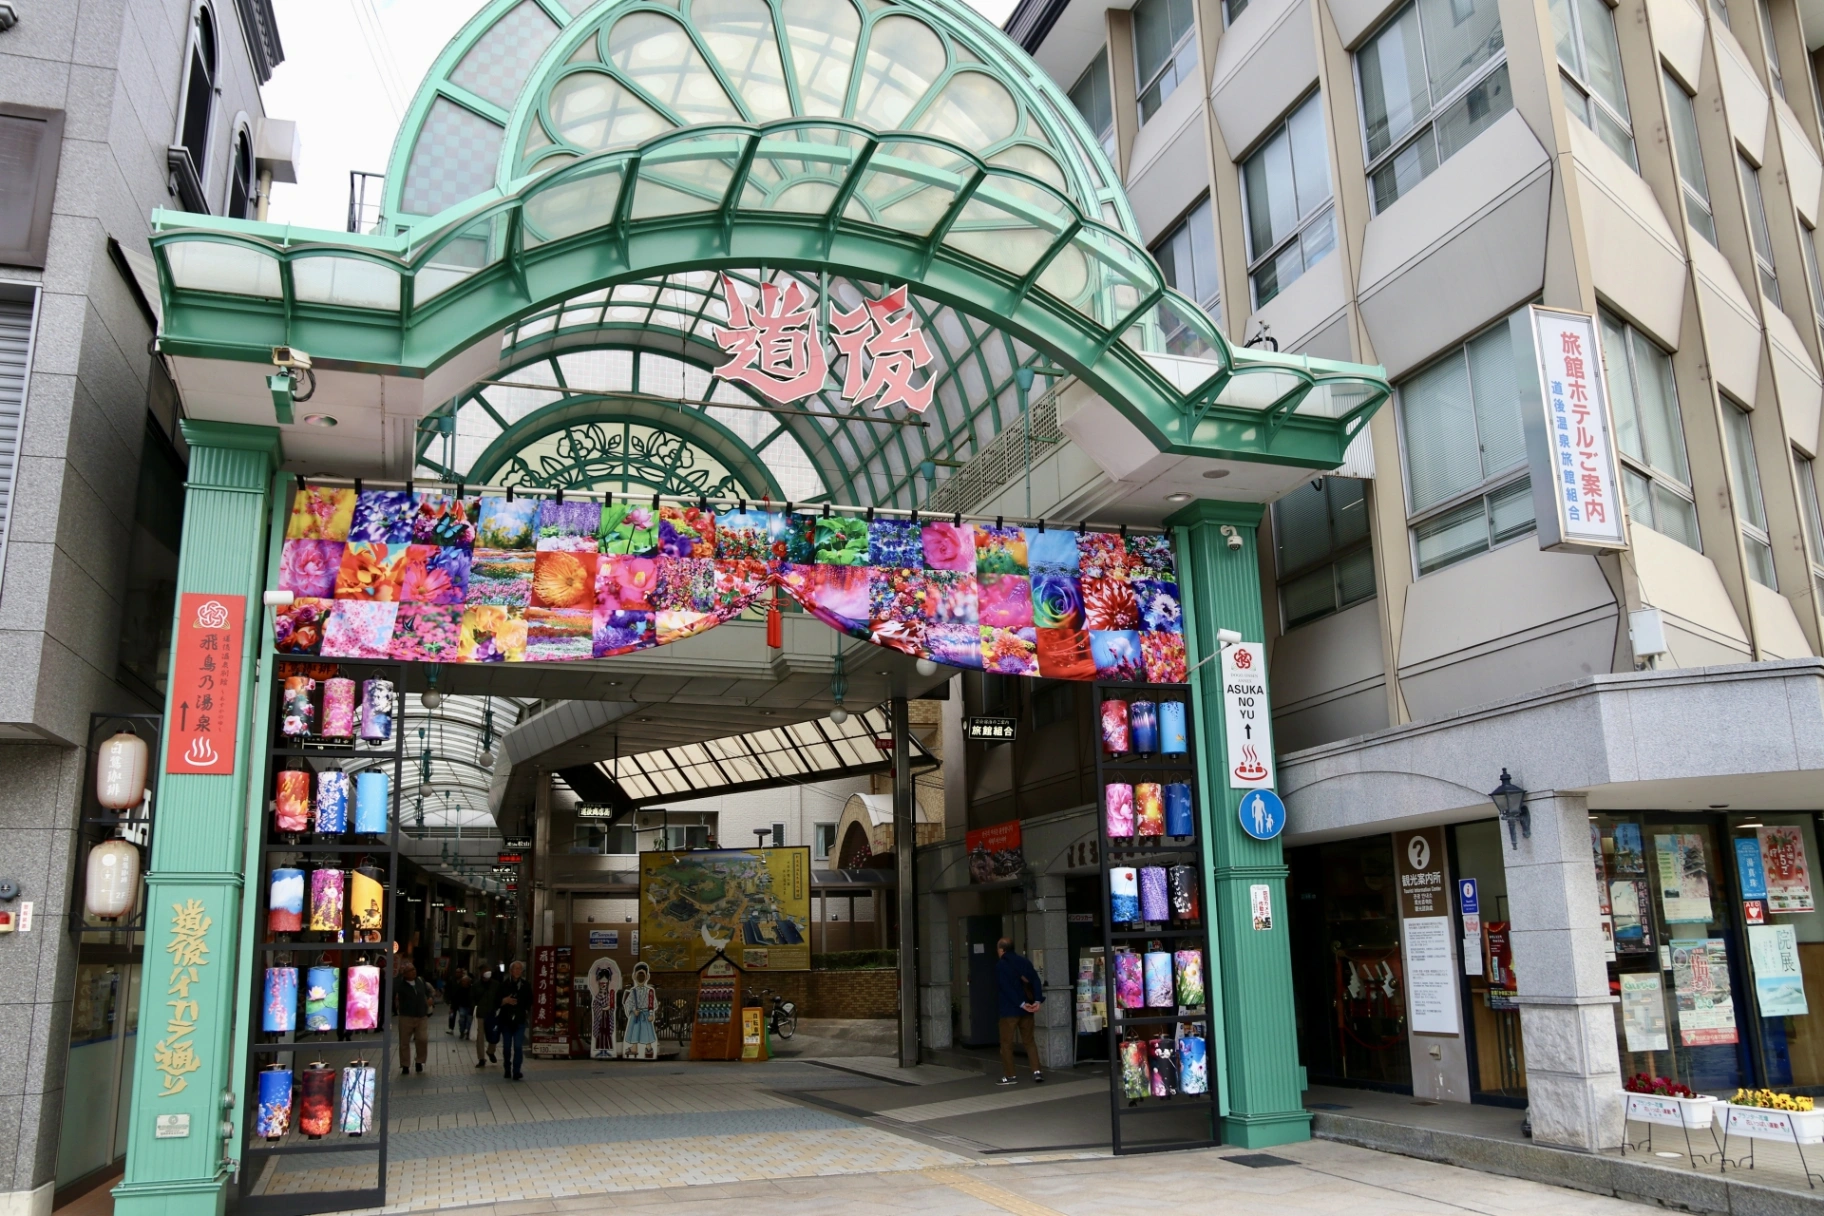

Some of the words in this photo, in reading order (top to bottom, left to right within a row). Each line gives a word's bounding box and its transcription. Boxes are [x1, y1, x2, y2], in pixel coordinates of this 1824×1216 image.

[713, 270, 938, 413] 道後
[1560, 331, 1606, 524] 旅館ホテルご案内
[1551, 380, 1580, 522] 道後温泉旅館組合
[193, 634, 218, 733] 飛鳥乃湯泉
[1227, 684, 1264, 695] ASUKA
[1238, 697, 1255, 707] NO
[1240, 709, 1255, 720] YU
[971, 725, 1014, 737] 旅館組合
[107, 741, 123, 797] 白鷺珈琲
[1402, 871, 1441, 887] 観光案内所
[1776, 929, 1796, 972] 院展
[537, 950, 549, 1020] 飛鳥乃湯泉
[154, 898, 212, 1097] 道後ハイカラ通り
[1637, 1099, 1663, 1108] プランター花壇
[1644, 1106, 1671, 1115] 花いっぱい運動
[1737, 1112, 1769, 1122] プランター花壇
[1745, 1119, 1779, 1129] 花いっぱい運動
